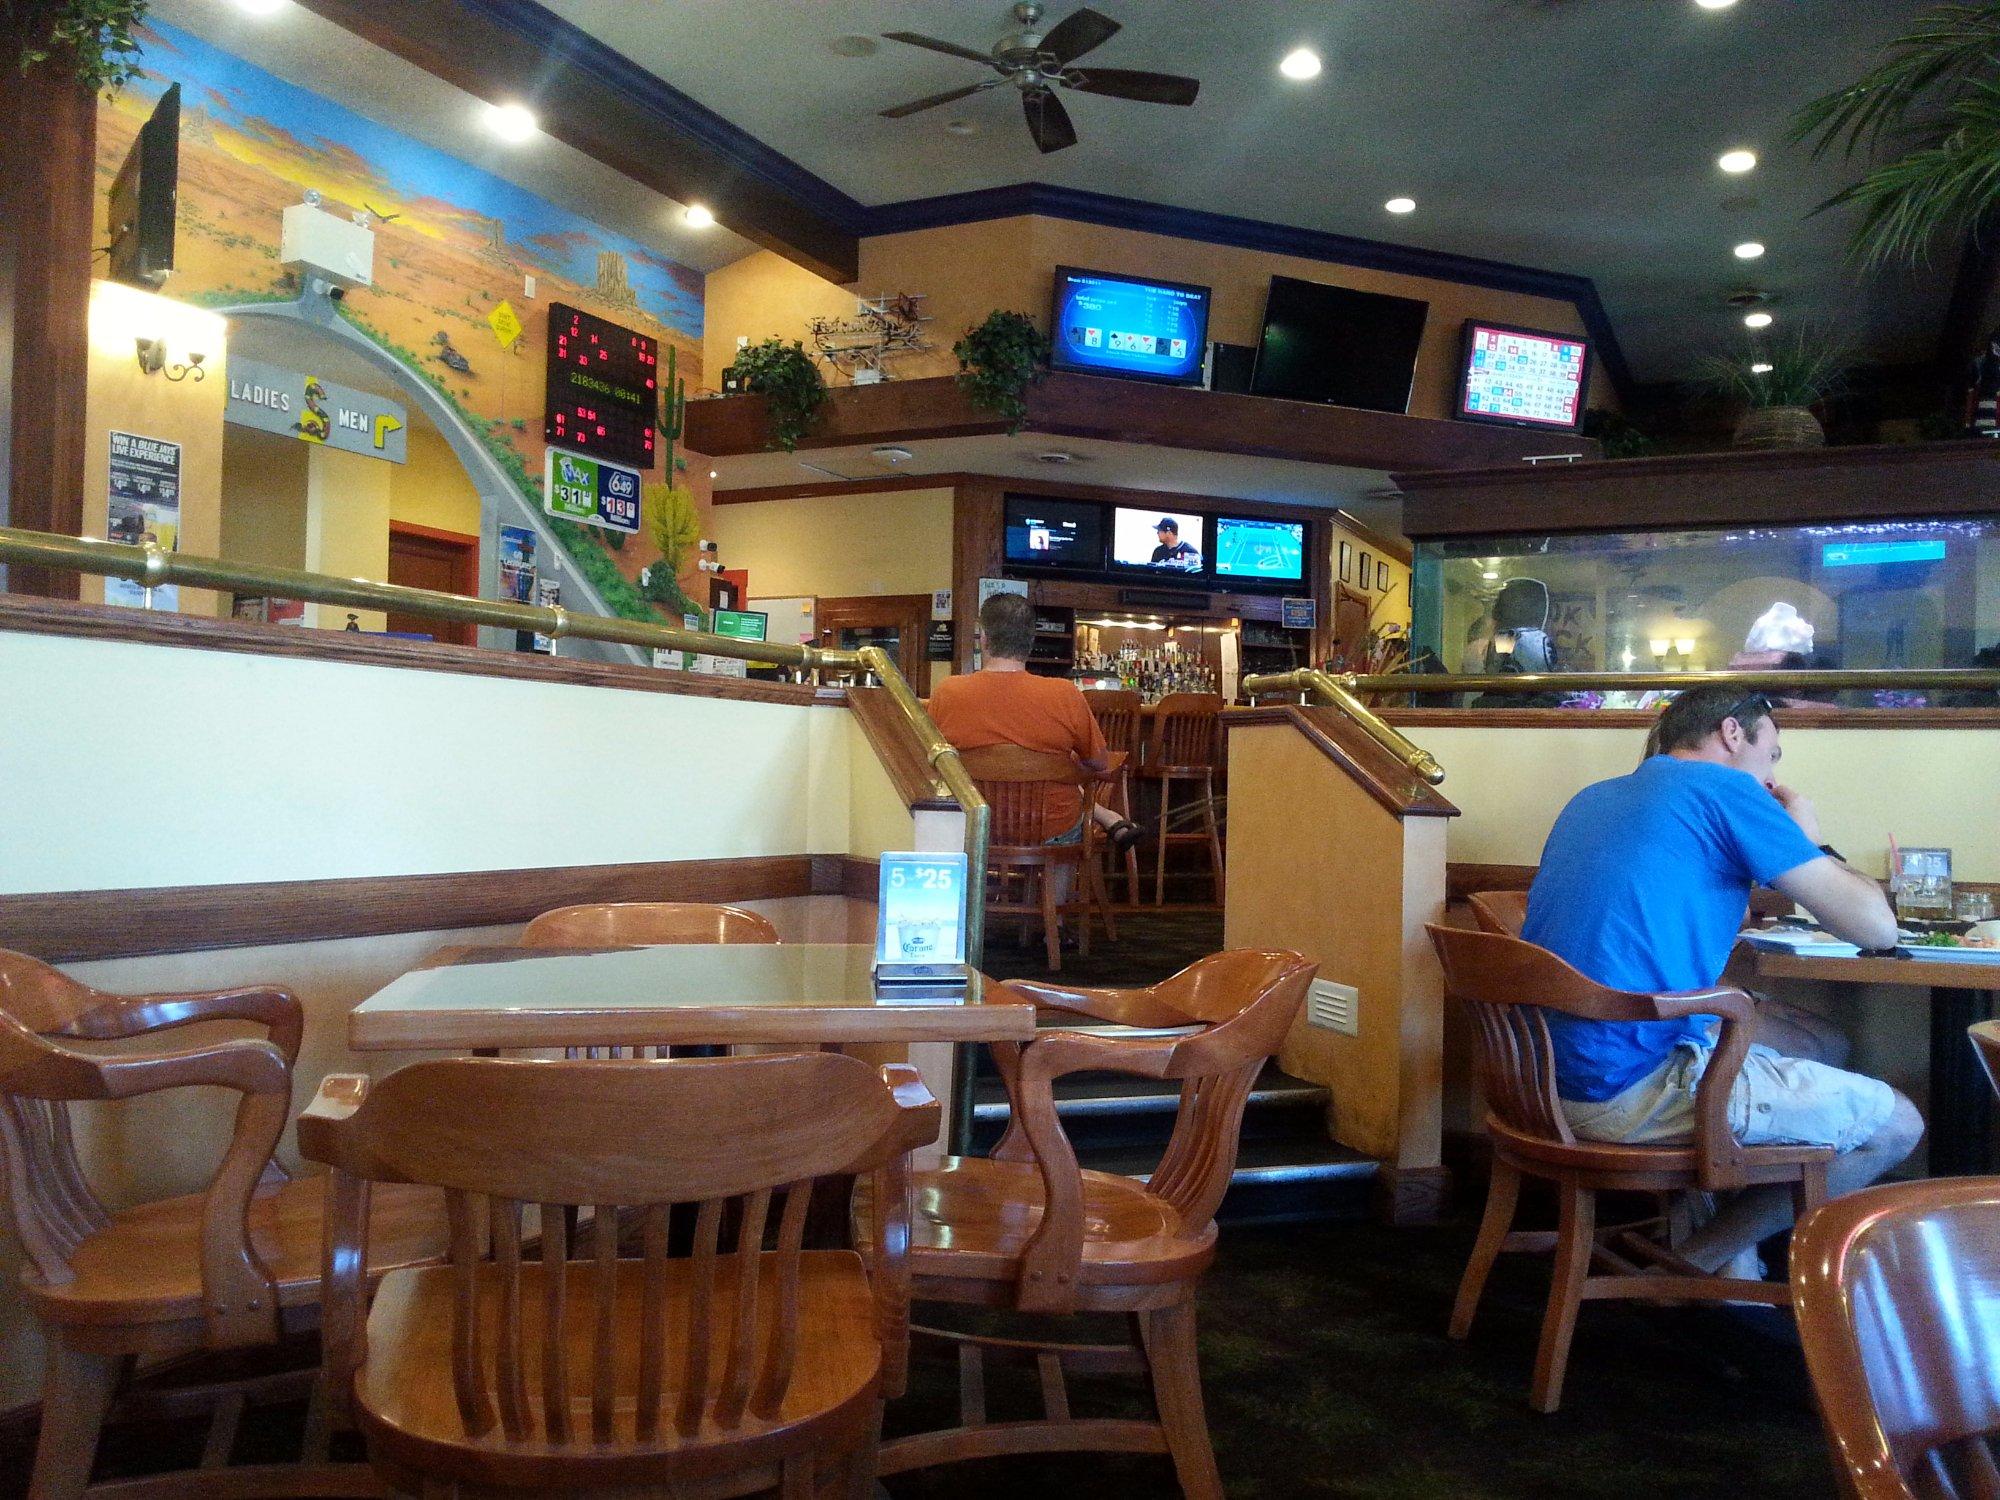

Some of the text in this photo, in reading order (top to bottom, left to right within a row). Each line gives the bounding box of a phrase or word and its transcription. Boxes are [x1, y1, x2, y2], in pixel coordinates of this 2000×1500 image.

[573, 315, 579, 324] 2
[231, 380, 290, 412] LADIES
[339, 408, 368, 432] MEN
[112, 432, 176, 456] WIN A BLUE JAYS
[112, 444, 176, 466] LIVE EXPERIENCE
[891, 867, 952, 890] 5 $25
